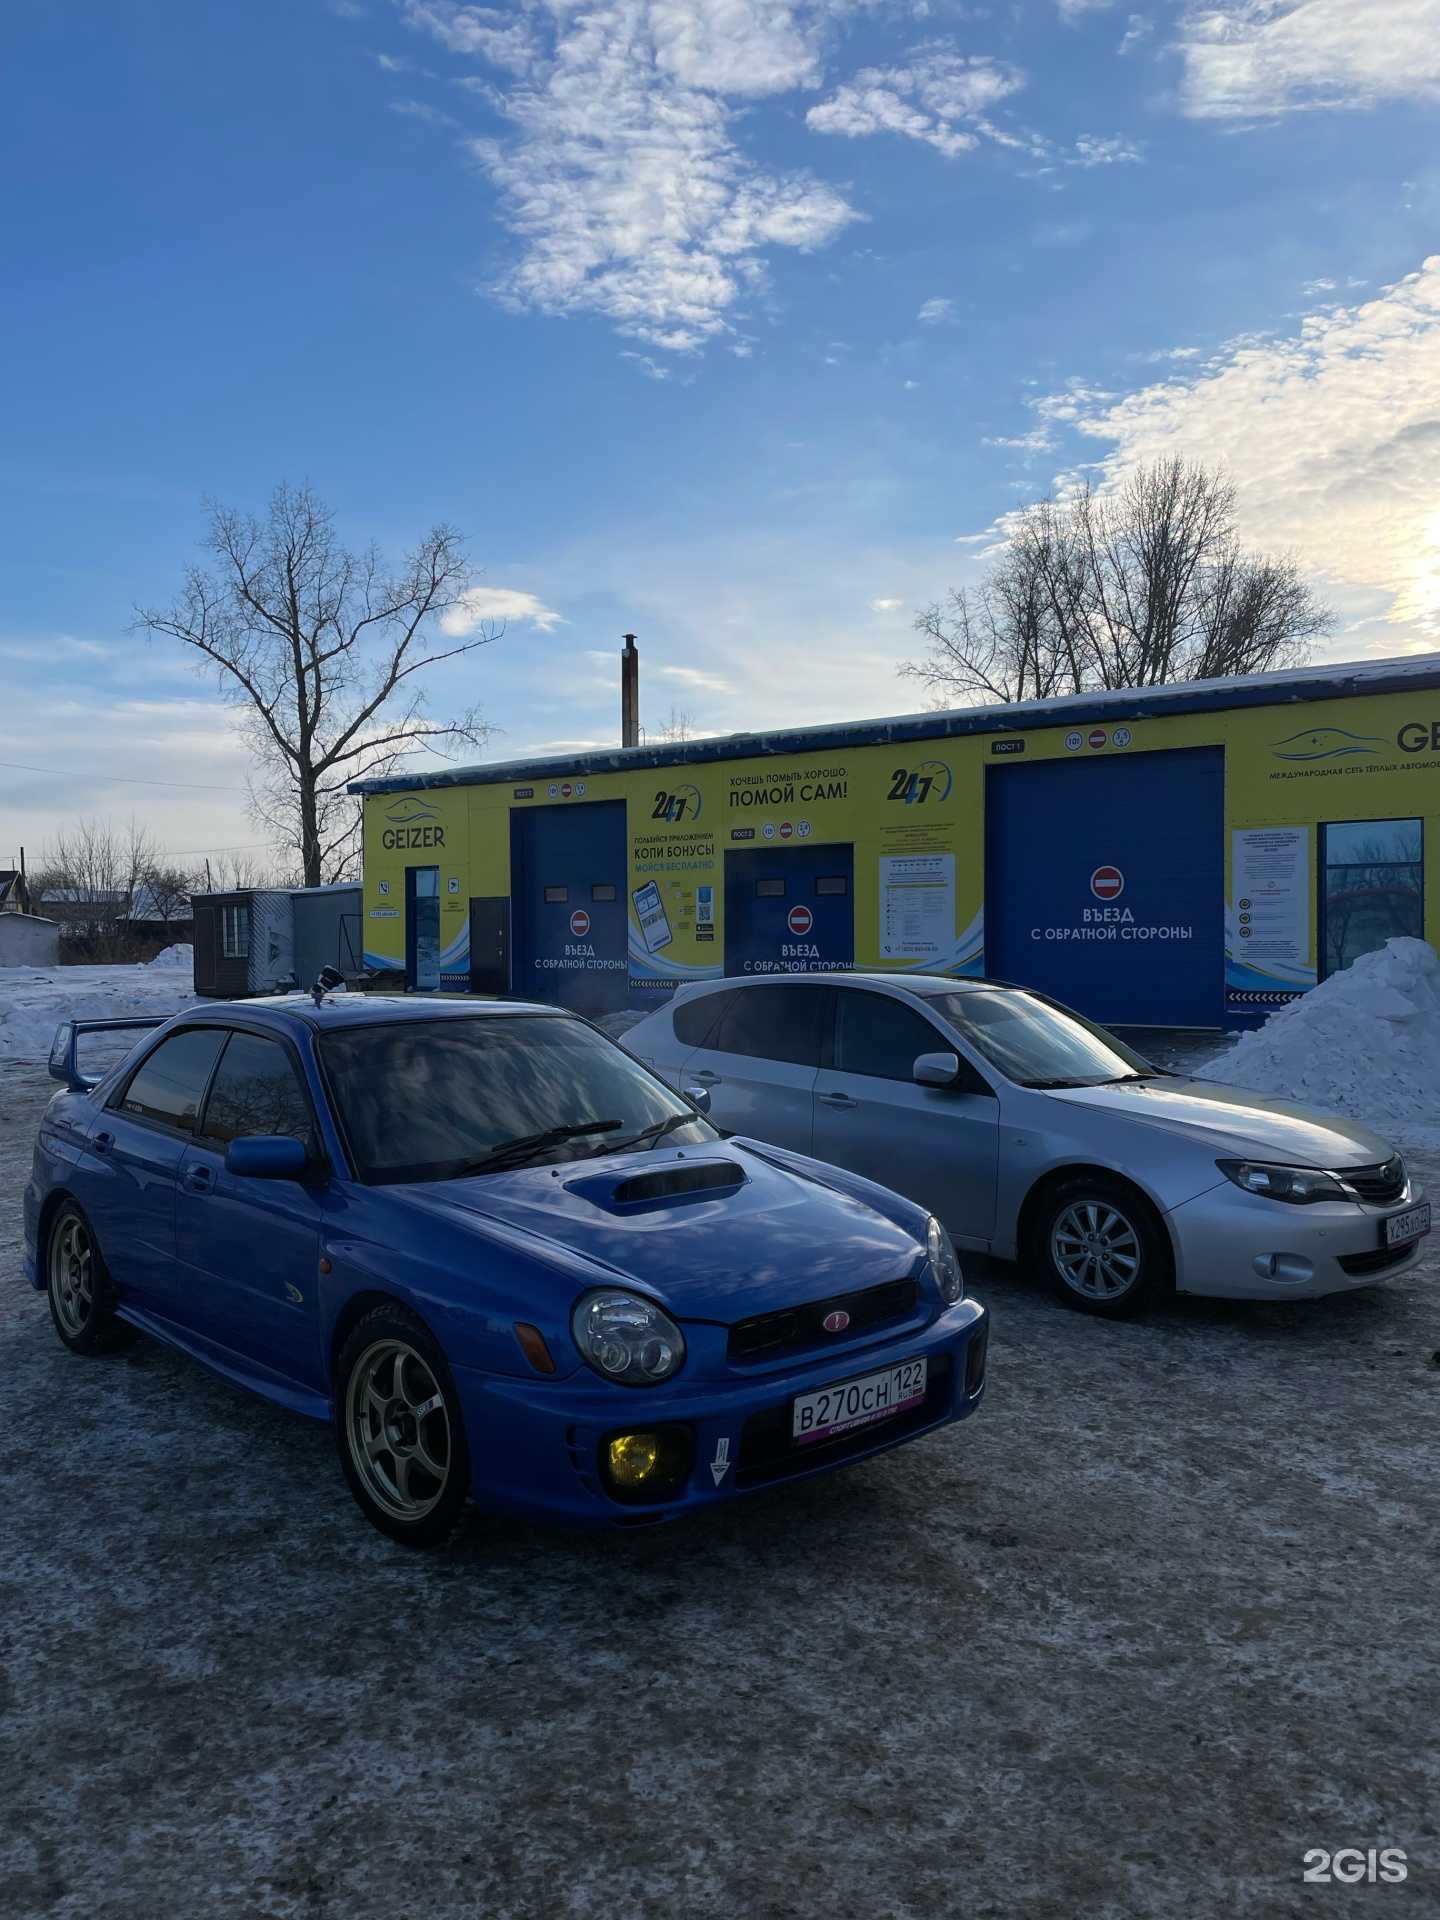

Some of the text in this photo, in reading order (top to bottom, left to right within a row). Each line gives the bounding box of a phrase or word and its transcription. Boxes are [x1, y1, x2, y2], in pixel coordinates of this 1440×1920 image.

[995, 743, 1015, 751] ПОСТ
[729, 776, 764, 786] ХОЧЕШЬ
[766, 772, 802, 783] ПОМЫТЬ
[1269, 767, 1343, 780] МЕЖДУНАРОДНАЯ
[1344, 766, 1364, 775] СЕТЬ
[729, 781, 848, 807] ПОМОЙ САМ!
[382, 826, 446, 850] GEIZER
[634, 844, 714, 859] КОПИ БОНУСЫ
[1083, 907, 1134, 923] ВЪЕЗД
[1031, 925, 1193, 940] С ОБРАТНОЙ СТОРОНЫ
[564, 944, 596, 957] ВЪЕЗД
[781, 944, 820, 958] ВЪЕЗД
[534, 958, 628, 970] С ОБРАТНОЙ СТОРОНЫ
[743, 960, 752, 971] С
[753, 959, 807, 972] ОБРАТНОЙ
[801, 1382, 889, 1431] В270СН
[894, 1363, 922, 1391] 122
